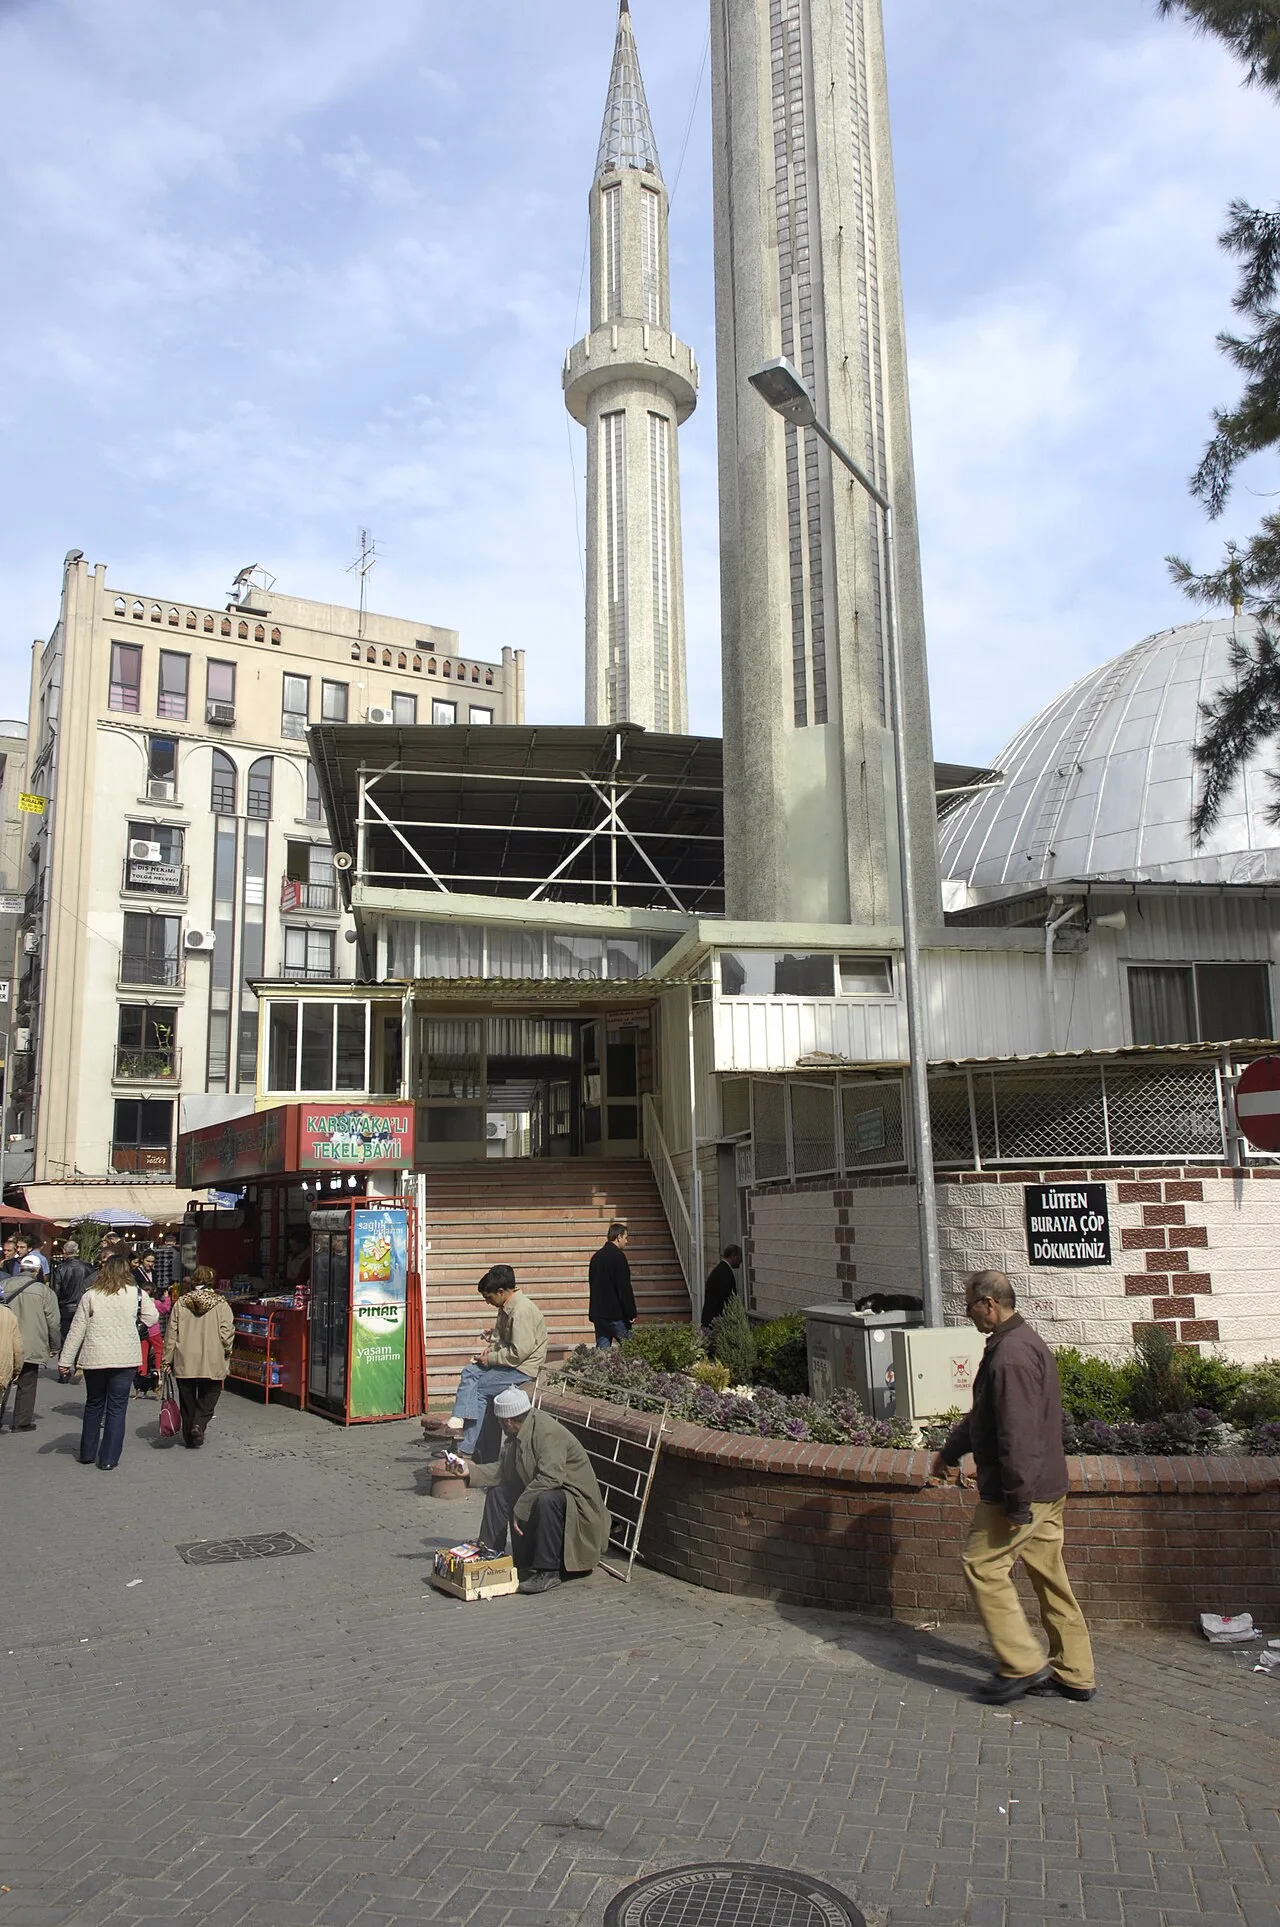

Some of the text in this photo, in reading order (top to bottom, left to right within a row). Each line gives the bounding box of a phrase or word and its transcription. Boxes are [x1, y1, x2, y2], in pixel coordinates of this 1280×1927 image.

[313, 1142, 359, 1158] TEKEL
[1041, 1189, 1088, 1209] LÜTFEN
[1031, 1211, 1105, 1235] BURAYA ÇÖP
[1034, 1238, 1106, 1259] DÖKMEYİNİZ
[359, 1306, 398, 1317] PINAR
